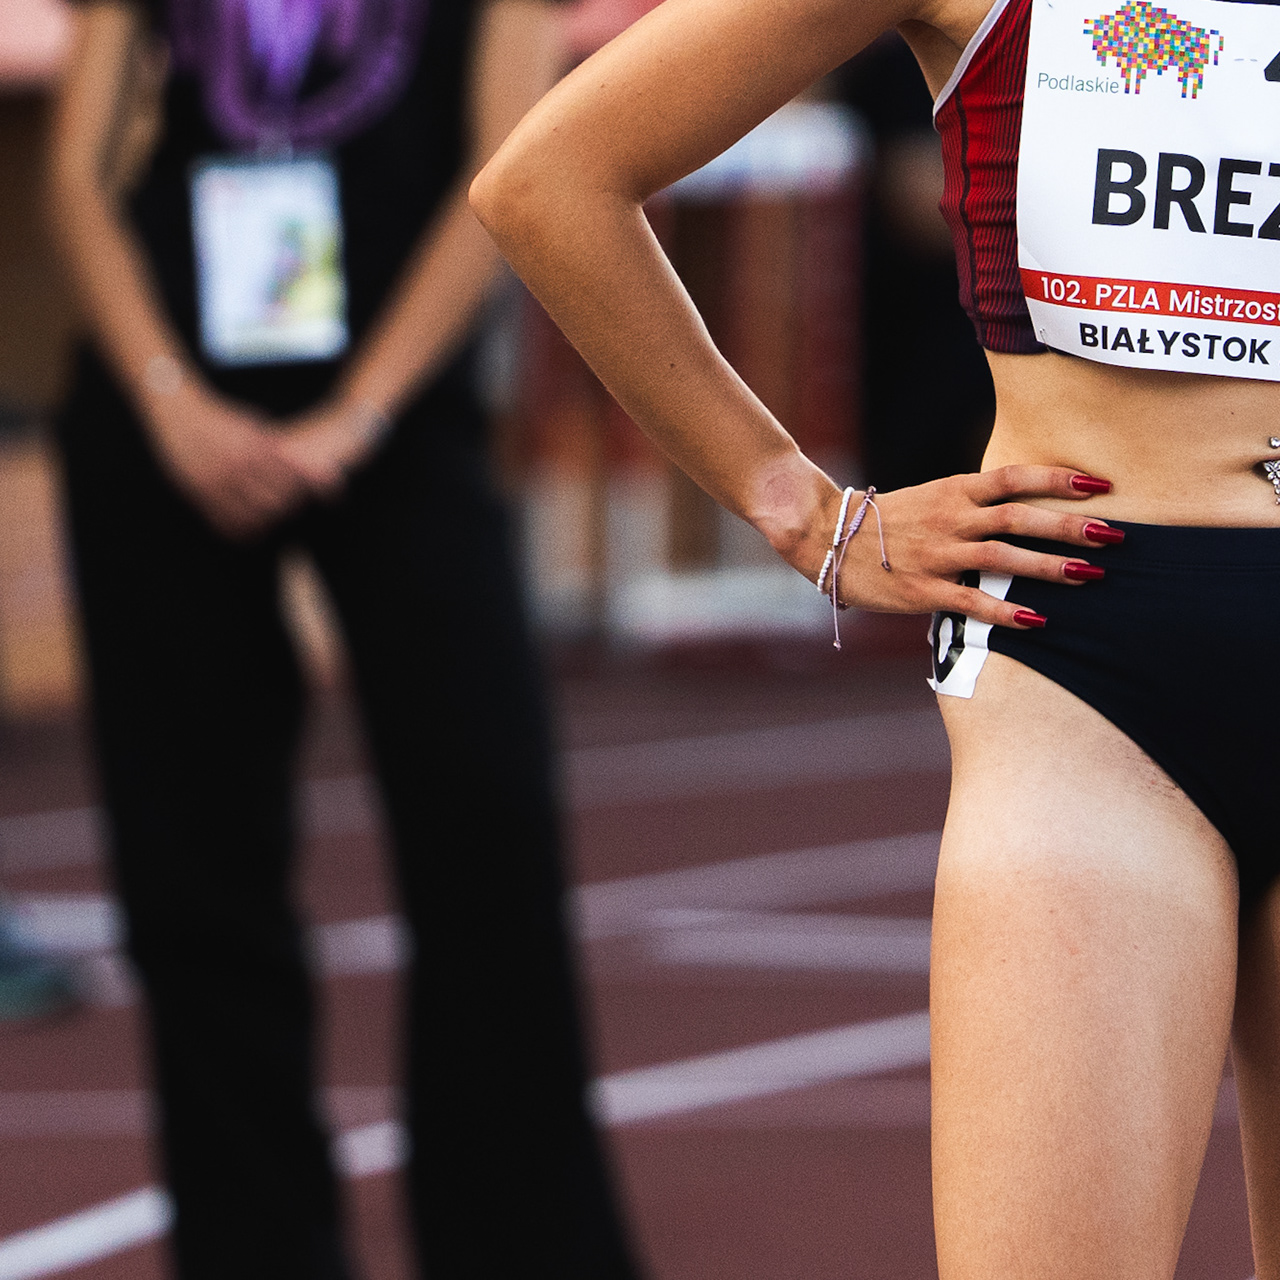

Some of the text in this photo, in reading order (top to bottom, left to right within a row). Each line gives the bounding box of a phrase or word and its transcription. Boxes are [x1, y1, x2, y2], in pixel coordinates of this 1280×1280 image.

[1036, 71, 1121, 95] Podlaskie
[1041, 276, 1089, 305] 102.
[1095, 283, 1161, 311] PZLA
[1078, 322, 1273, 366] BIAŁYSTOK
